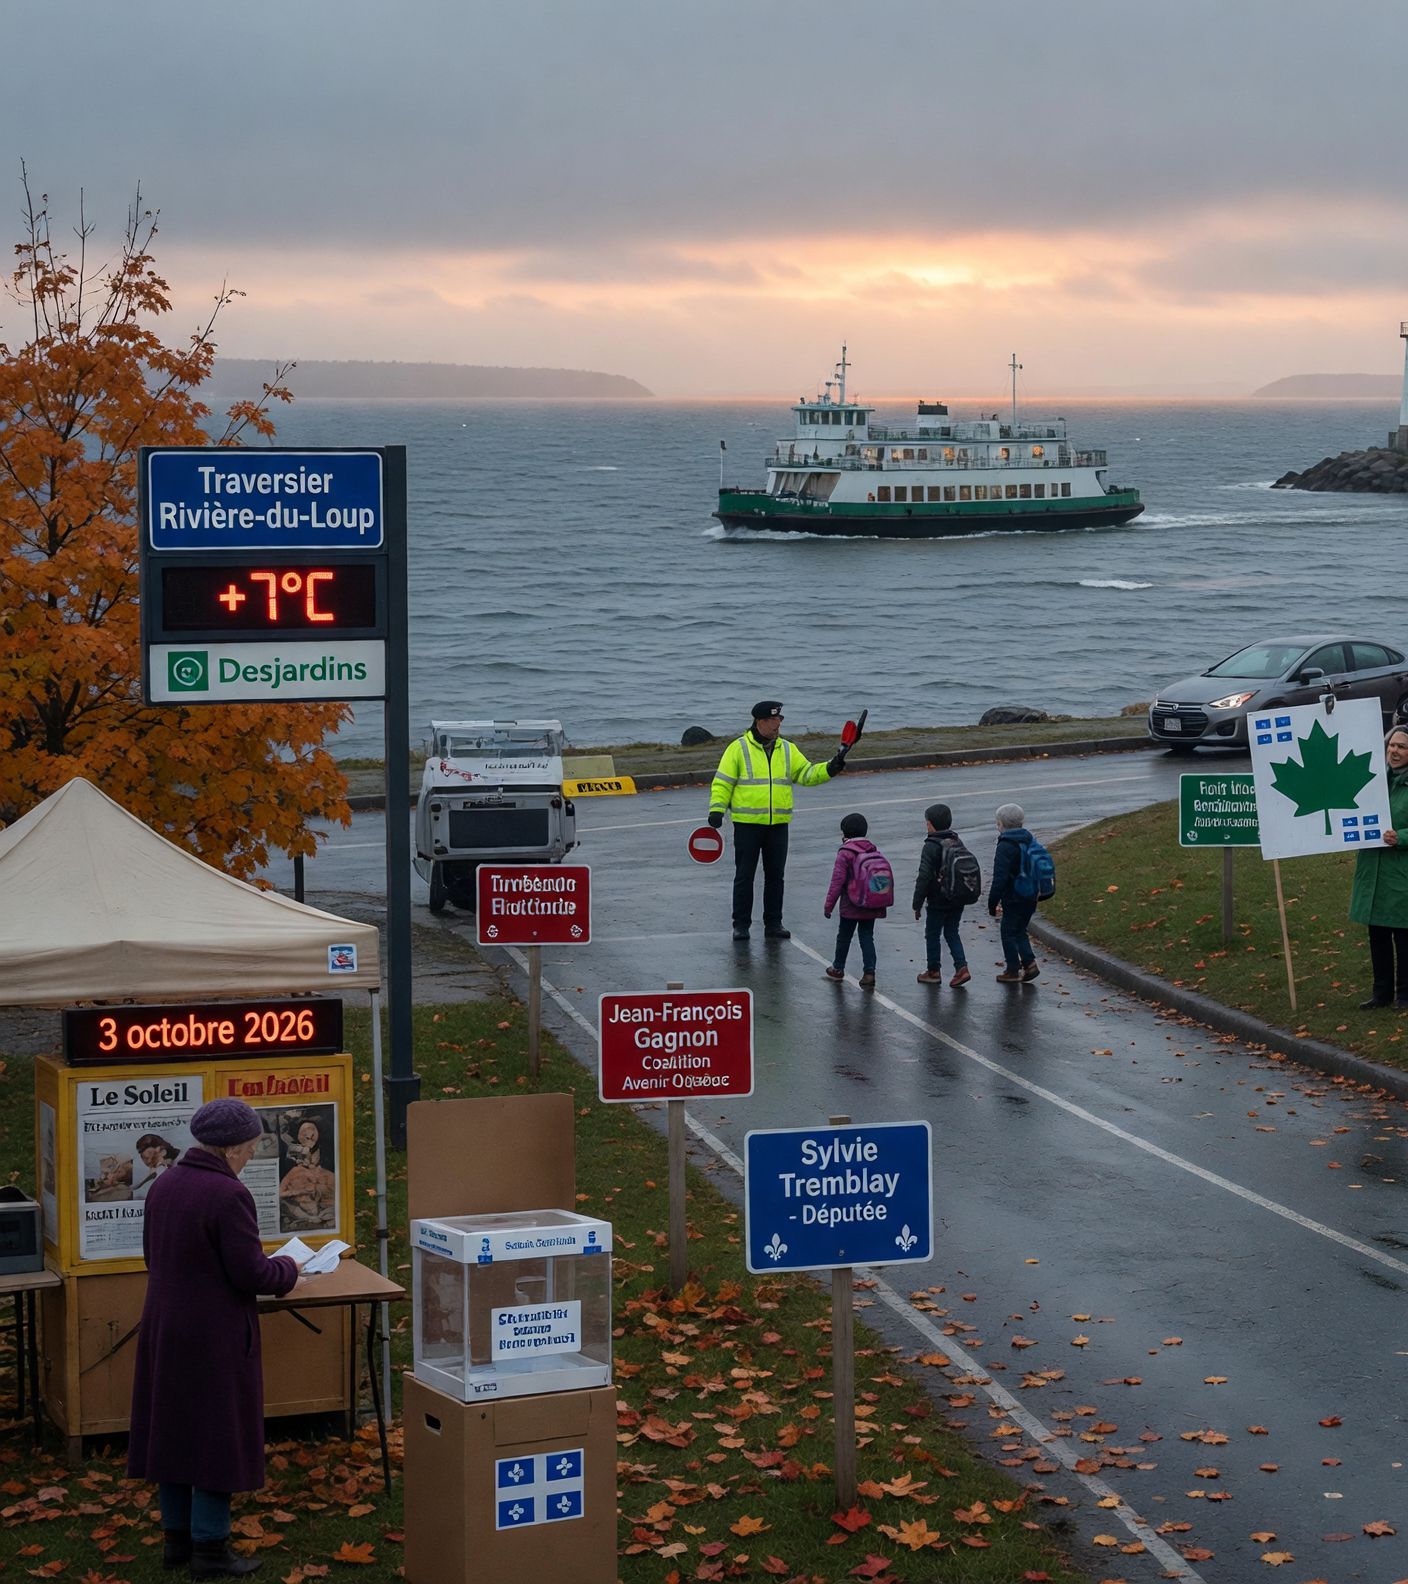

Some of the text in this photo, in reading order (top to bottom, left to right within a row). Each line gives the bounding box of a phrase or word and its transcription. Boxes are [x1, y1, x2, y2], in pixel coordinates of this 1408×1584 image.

[198, 466, 333, 494] Traversier
[159, 501, 375, 535] Rivière-du-Loup
[219, 572, 334, 621] +7°C
[218, 656, 367, 688] Desjardins
[609, 1000, 742, 1024] Jean-François
[99, 1009, 314, 1050] 3 octobre 2026
[634, 1027, 718, 1053] Gagnon
[90, 1082, 189, 1107] Le Soleil
[622, 1075, 670, 1090] Avenir
[801, 1136, 878, 1170] Sylvie
[778, 1167, 900, 1198] Tremblay
[802, 1200, 888, 1228] Députée
